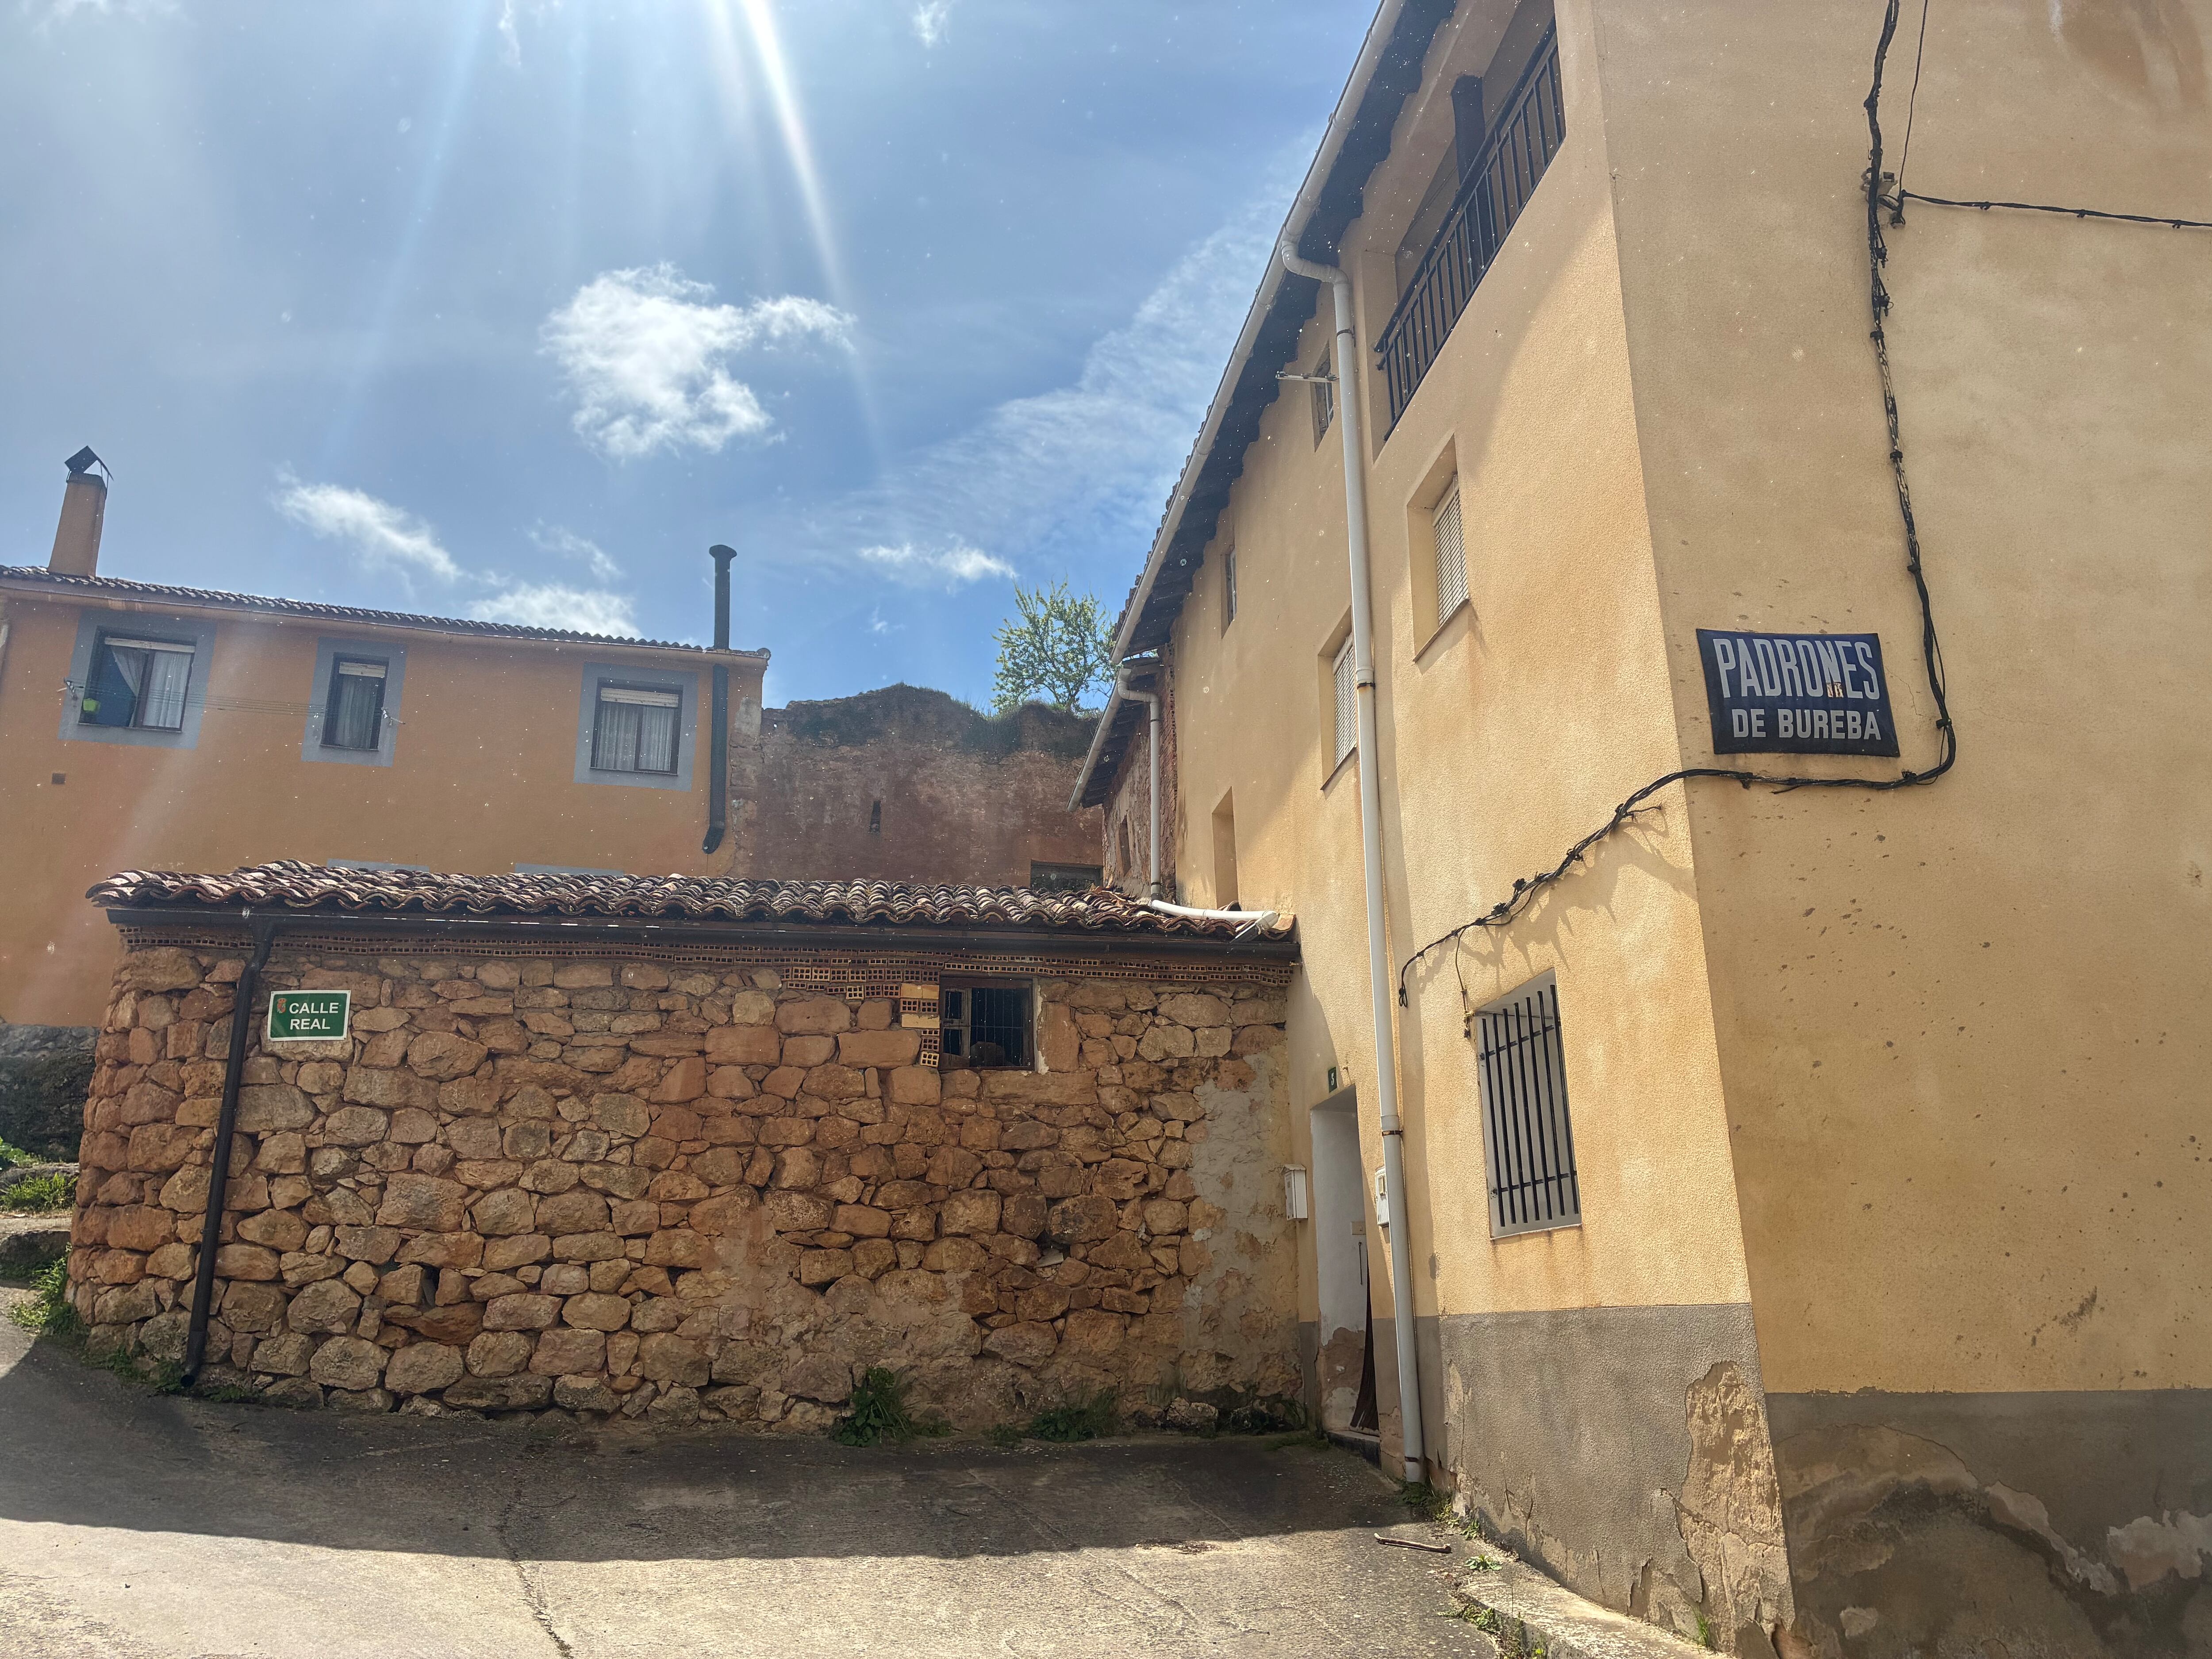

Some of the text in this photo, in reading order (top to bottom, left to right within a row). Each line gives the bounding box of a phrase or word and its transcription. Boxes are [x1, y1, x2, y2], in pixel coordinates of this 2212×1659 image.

[1713, 638, 1880, 699] PADRONES
[1732, 709, 1881, 740] DE BUREBA
[289, 1002, 339, 1014] CALLE
[290, 1018, 330, 1030] REAL
